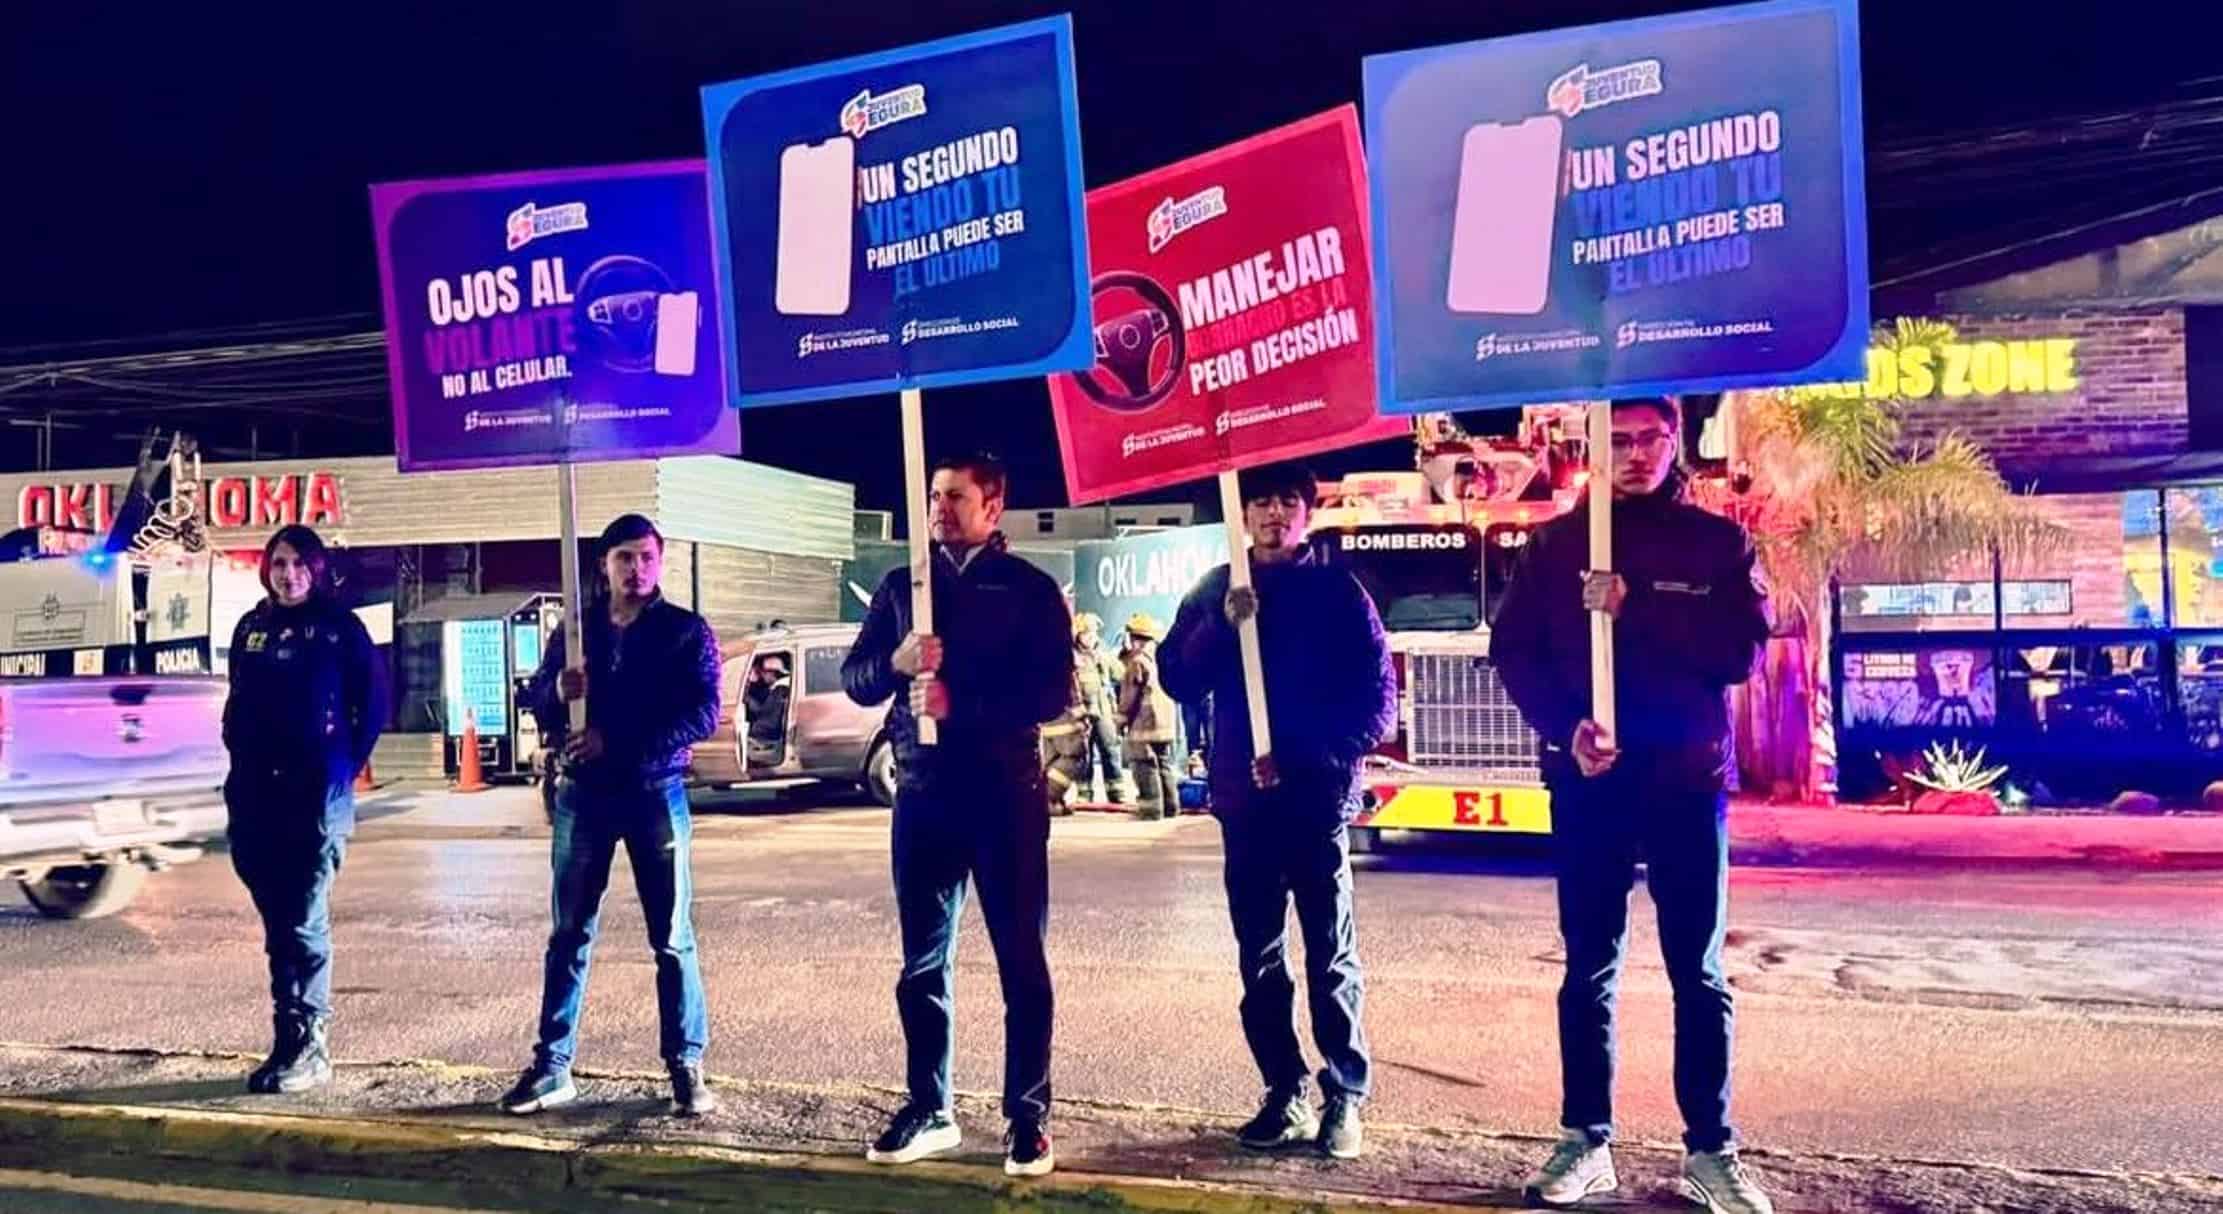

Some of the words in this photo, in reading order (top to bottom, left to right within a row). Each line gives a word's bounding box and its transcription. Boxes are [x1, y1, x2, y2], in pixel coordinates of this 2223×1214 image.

[863, 162, 896, 203] UN
[901, 126, 1018, 194] SEGUNDO
[1572, 147, 1616, 190] UN
[1626, 111, 1780, 181] SEGUNDO
[865, 178, 972, 245] VIENDO
[981, 165, 1020, 216] TU
[1575, 165, 1717, 236] VIENDO
[1729, 153, 1781, 205] TU
[866, 232, 940, 271] PANTALLA
[942, 217, 991, 250] PUEDE
[993, 209, 1024, 235] SER
[1573, 224, 1671, 264] PANTALLA
[1676, 210, 1739, 246] PUEDE
[1743, 203, 1785, 231] SER
[427, 265, 520, 326] OJOS
[531, 256, 575, 308] AL
[895, 264, 919, 296] EL
[1178, 226, 1345, 331] MANEJAR
[1291, 288, 1317, 318] ES
[1319, 276, 1347, 305] LA
[1610, 259, 1640, 291] EL
[424, 308, 576, 374] VOLANTE
[918, 322, 981, 338] DESARROLLO
[983, 316, 1019, 331] SOCIAL
[1189, 347, 1249, 396] PEOR
[1251, 306, 1360, 375] DECISIÓN
[1514, 341, 1531, 352] LA
[1533, 335, 1600, 352] JUVENTUD
[1638, 325, 1723, 342] DESARROLLO
[1725, 320, 1773, 336] SOCIAL
[442, 373, 466, 399] NO
[470, 369, 492, 394] AL
[495, 354, 573, 390] CELULAR.
[1941, 340, 2080, 396] ZONE
[1341, 532, 1466, 550] BOMBEROS
[1843, 653, 1863, 677] 5
[1453, 790, 1508, 826] E1
